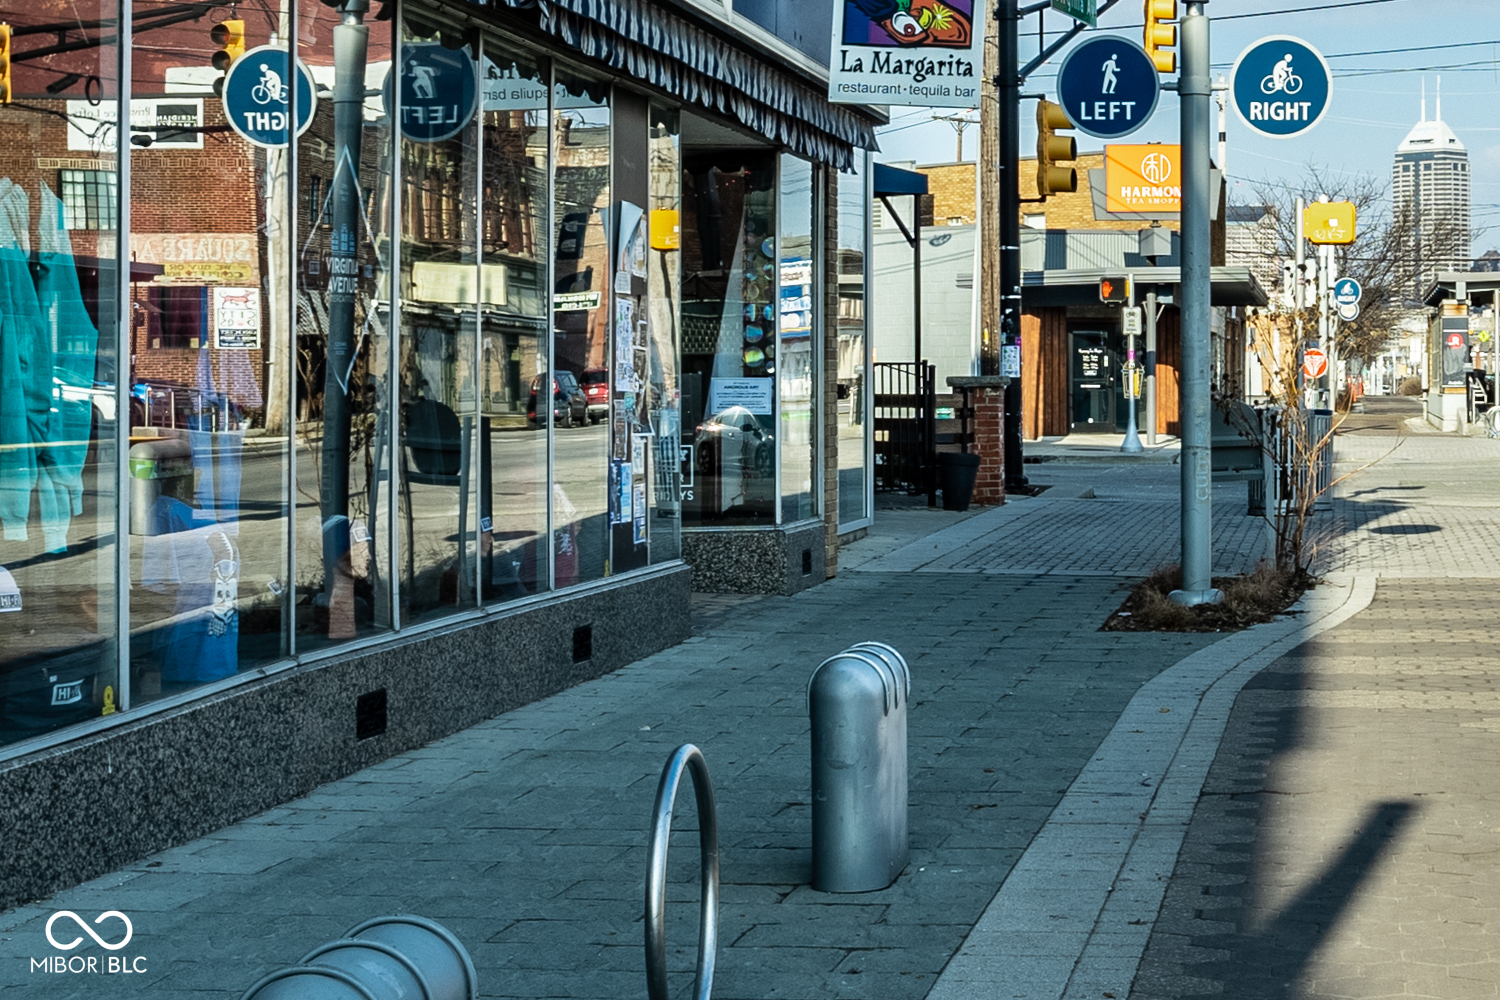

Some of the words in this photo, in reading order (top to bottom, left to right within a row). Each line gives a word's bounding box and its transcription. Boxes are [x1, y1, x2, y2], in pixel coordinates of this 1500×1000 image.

[840, 50, 864, 73] La
[869, 50, 974, 83] Margarita
[838, 82, 901, 95] restaurant
[908, 84, 950, 98] tequila
[954, 85, 976, 97] bar
[1080, 101, 1136, 121] LEFT
[1250, 101, 1312, 122] RIGHT
[1121, 186, 1182, 198] HARMON
[325, 256, 359, 275] VIRGINIA
[326, 276, 359, 294] AVENUE
